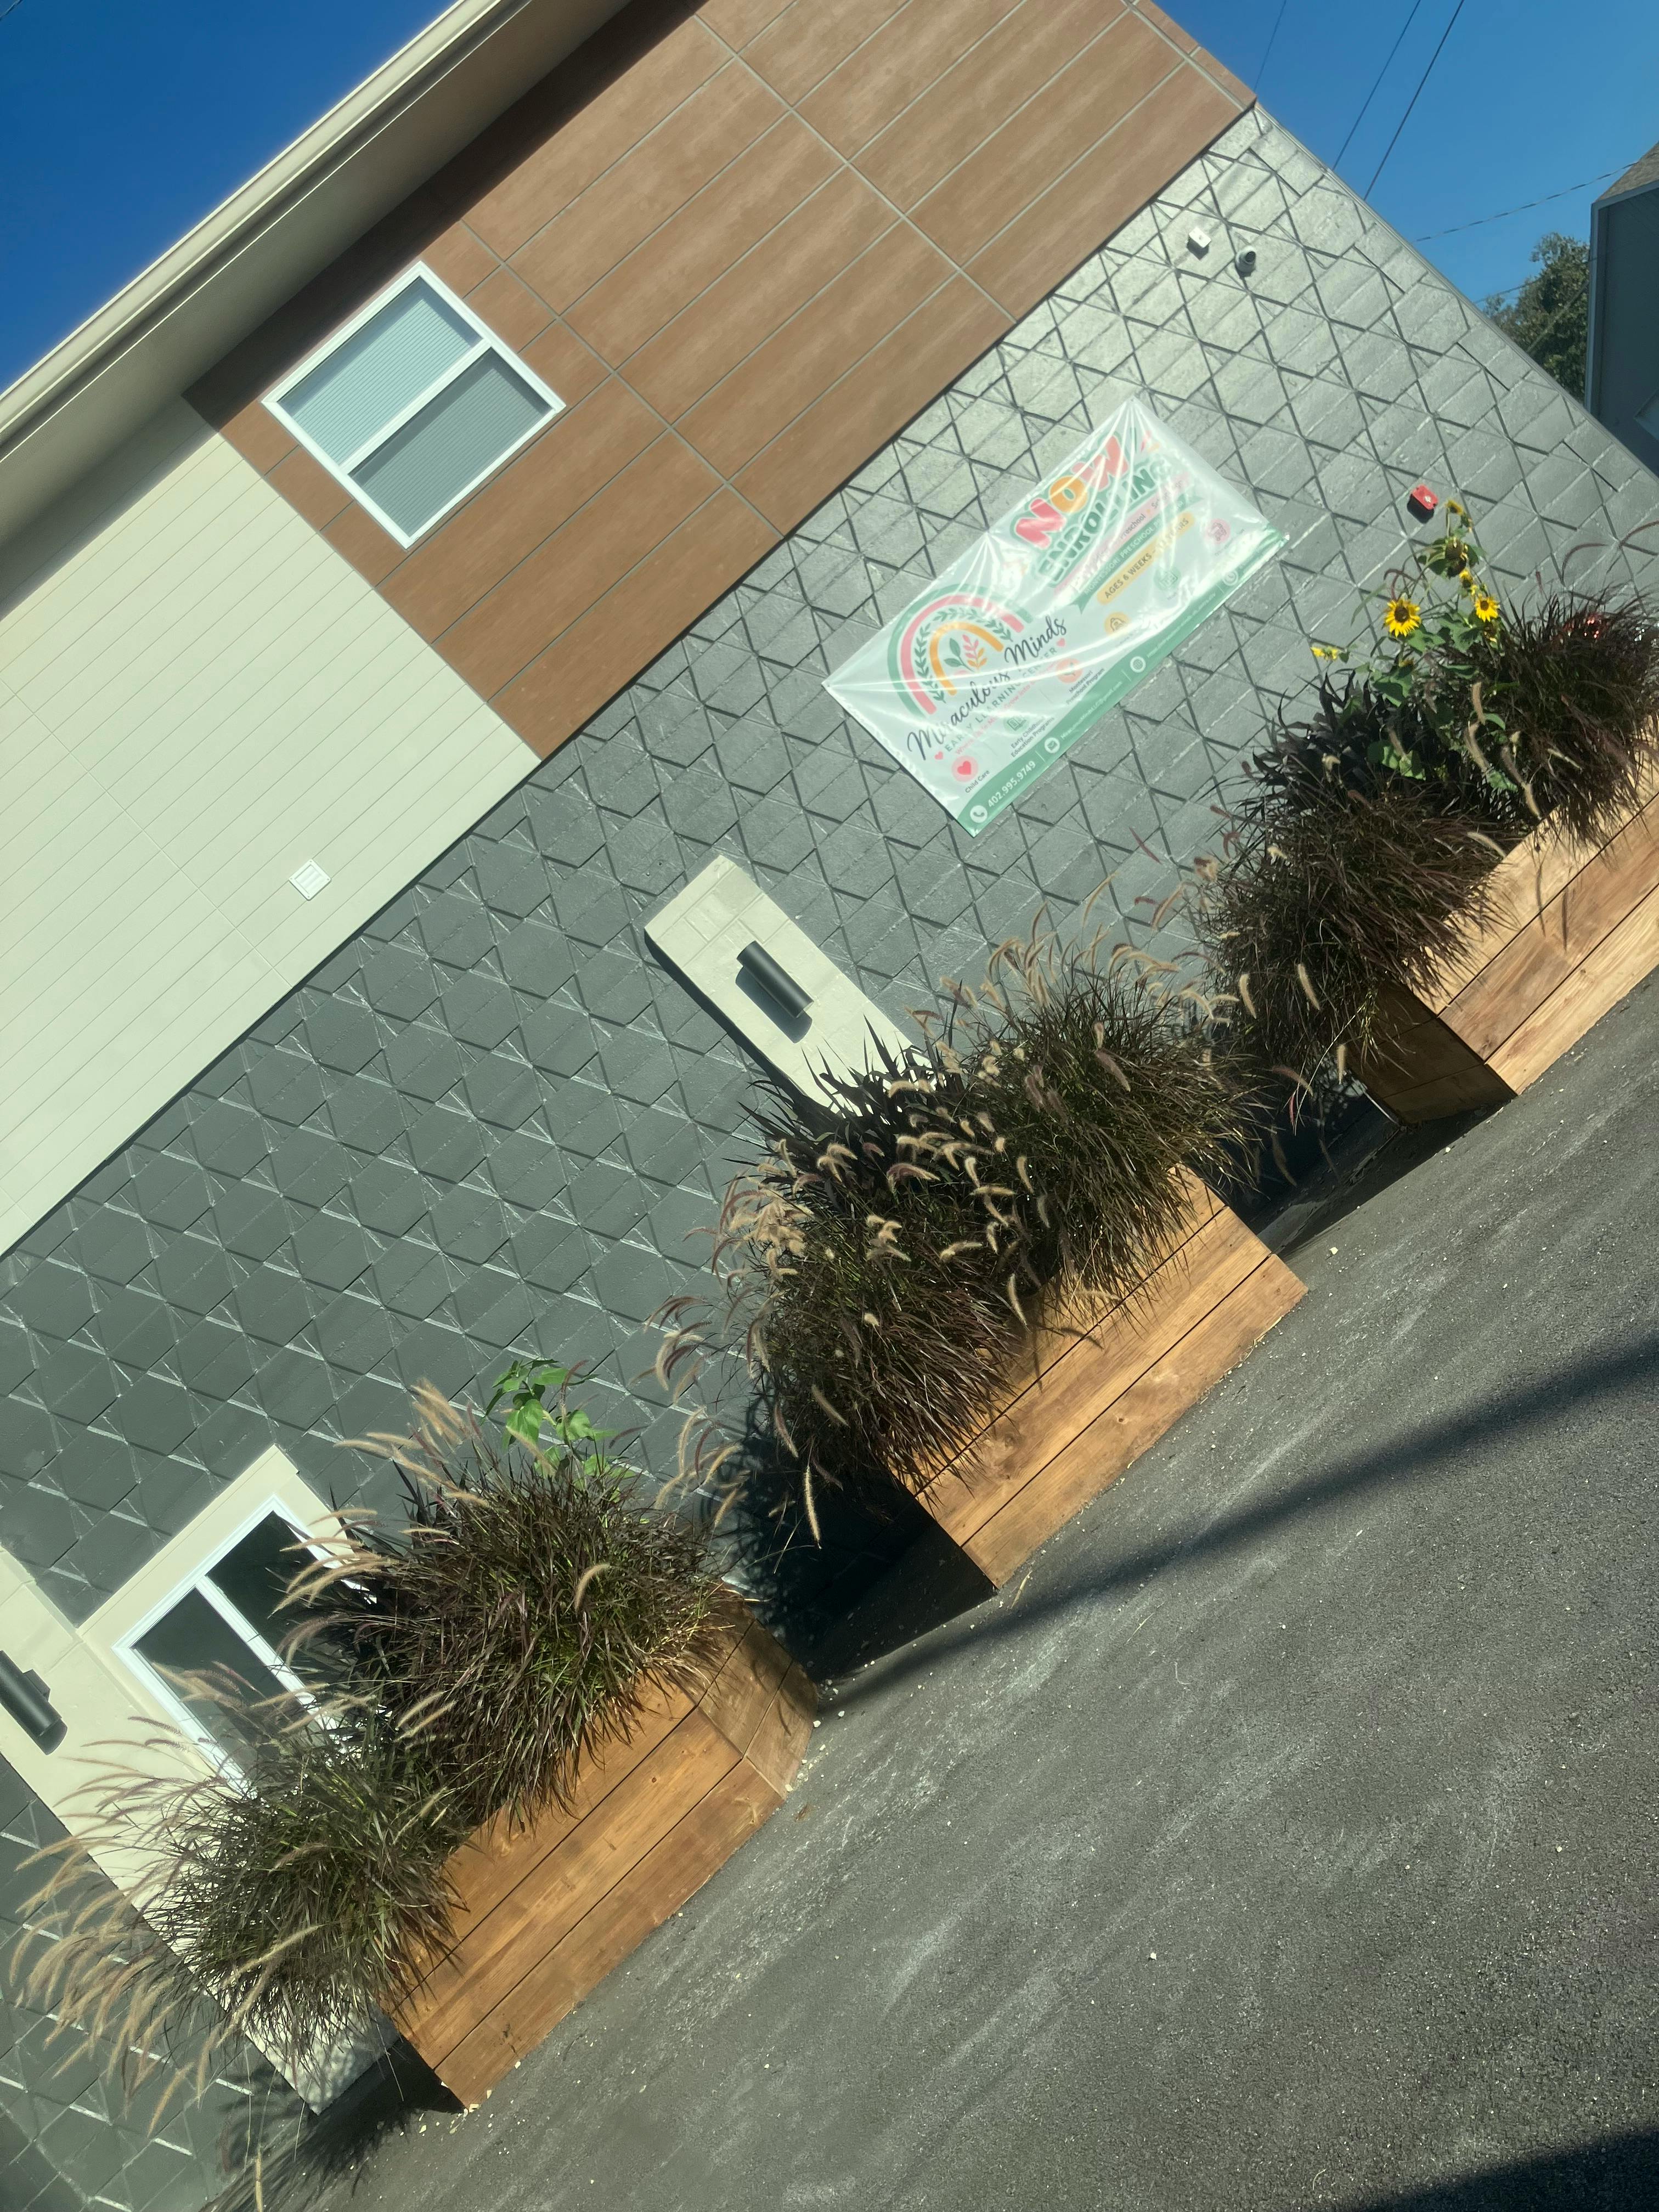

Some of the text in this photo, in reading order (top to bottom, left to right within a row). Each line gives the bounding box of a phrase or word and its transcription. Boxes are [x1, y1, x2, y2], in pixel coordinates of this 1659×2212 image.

[1015, 435, 1130, 548] NOW
[1150, 489, 1171, 510] Schol
[1119, 525, 1155, 558] PRESCHOOL
[1153, 499, 1184, 528] PRAM
[1103, 578, 1124, 599] AGES
[1121, 573, 1130, 582] 6
[1126, 551, 1153, 577] WEEKS
[1005, 616, 1066, 665] Minds
[1068, 669, 1094, 693] Montessori
[1085, 667, 1106, 687] Program
[944, 722, 975, 752] EARY
[1021, 646, 1058, 680] CENER
[1010, 735, 1025, 749] Early
[1010, 735, 1035, 758] Education
[964, 769, 991, 794] Child Care
[985, 759, 1037, 808] 402.995.9749
